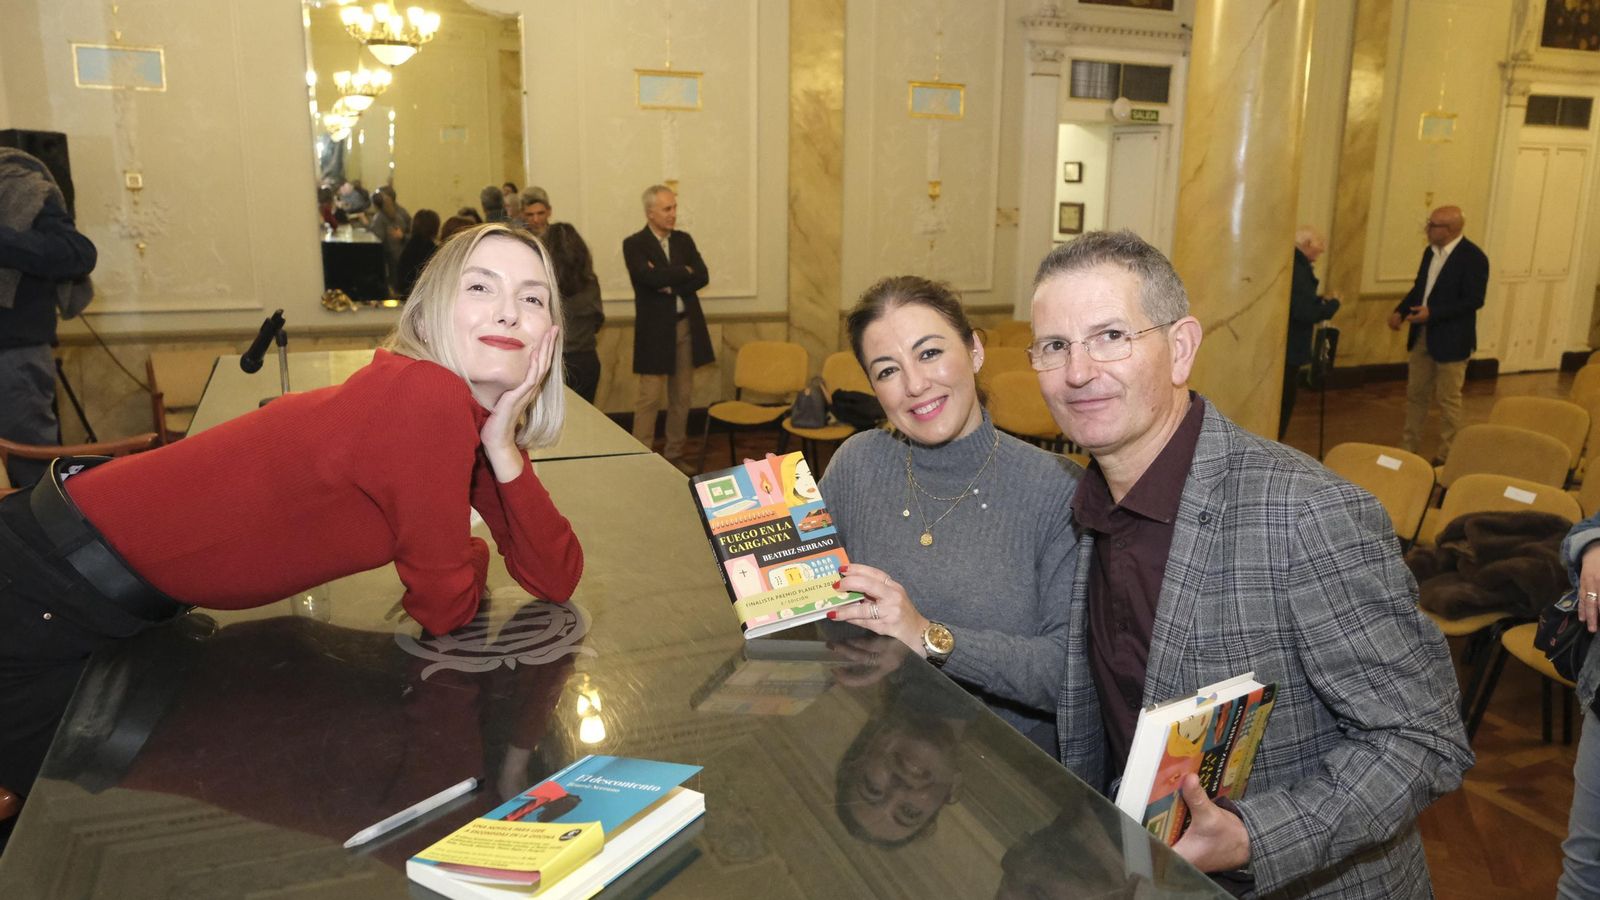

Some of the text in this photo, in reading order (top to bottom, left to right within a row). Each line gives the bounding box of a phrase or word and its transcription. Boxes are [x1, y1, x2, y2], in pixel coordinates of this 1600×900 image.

[1133, 110, 1157, 120] SALIDA
[719, 521, 792, 546] FUEGO EN LA
[728, 532, 791, 554] GARGANTA
[762, 538, 834, 562] BEATRIZ SERRANO
[745, 597, 775, 608] FINALISTA
[775, 591, 798, 600] PREMIO
[798, 584, 822, 594] PLANETA
[588, 775, 661, 792] descontento
